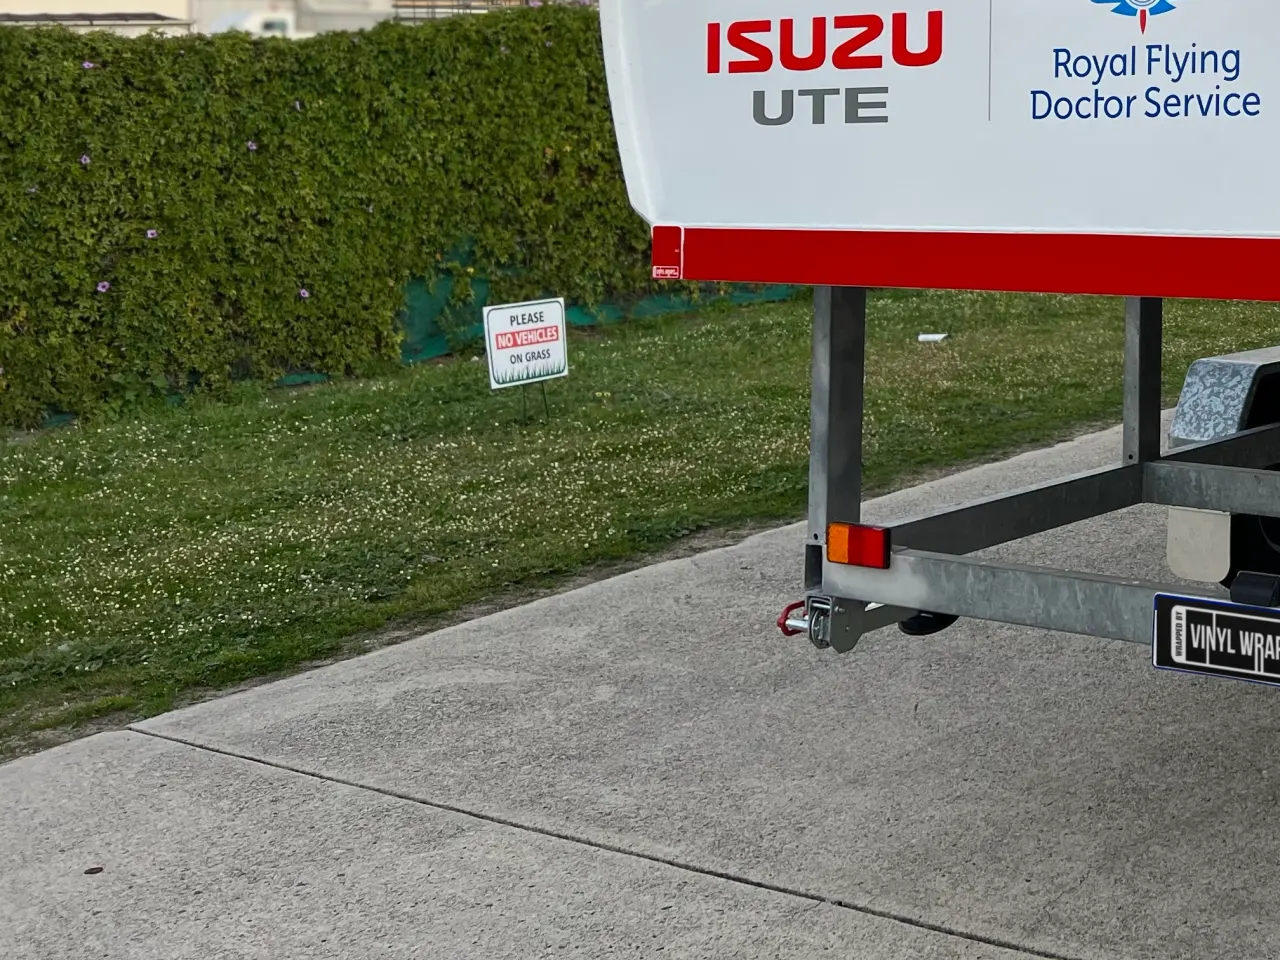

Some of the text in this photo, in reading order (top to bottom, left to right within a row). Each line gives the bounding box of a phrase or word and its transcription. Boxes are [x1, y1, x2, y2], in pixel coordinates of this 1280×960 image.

[706, 10, 943, 75] ISUZU
[1052, 43, 1241, 86] Royal Flying
[752, 86, 889, 126] UTE
[1030, 86, 1261, 120] Doctor Service
[510, 311, 544, 326] PLEASE
[497, 327, 557, 348] NO VEHICLES
[510, 349, 550, 364] ON GRASS
[1174, 610, 1184, 657] WRAPPED BY
[1190, 622, 1236, 655] VINYL
